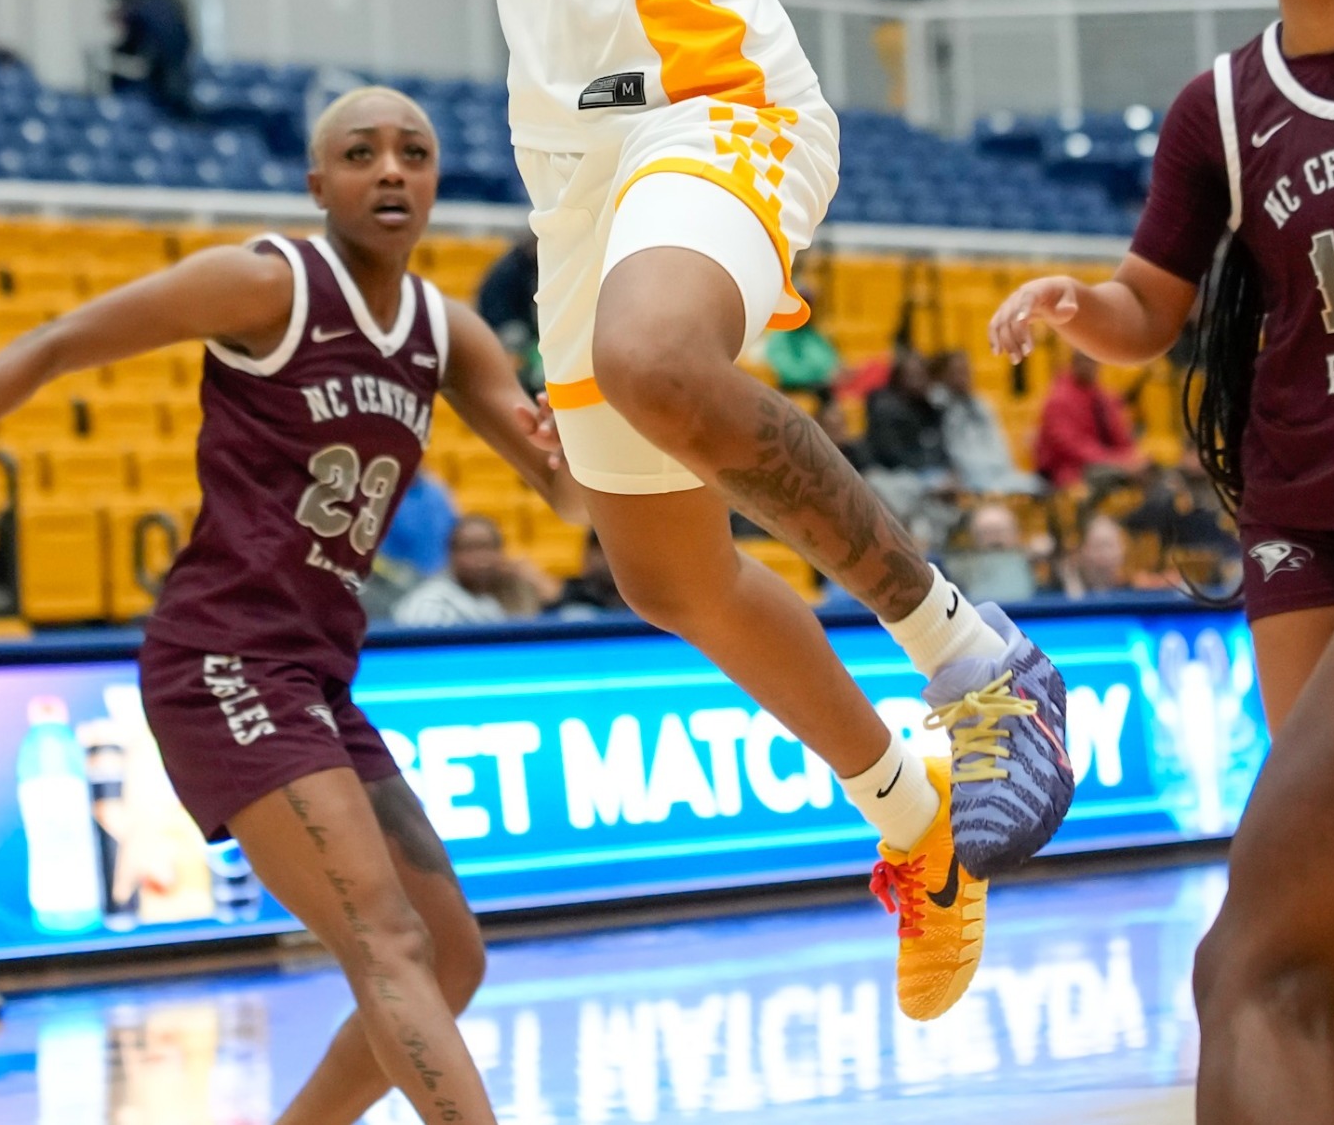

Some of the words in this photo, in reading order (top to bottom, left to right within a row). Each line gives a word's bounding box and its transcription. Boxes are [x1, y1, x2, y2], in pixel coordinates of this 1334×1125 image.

[622, 82, 635, 96] M
[1263, 174, 1302, 231] NC
[301, 378, 349, 423] NC
